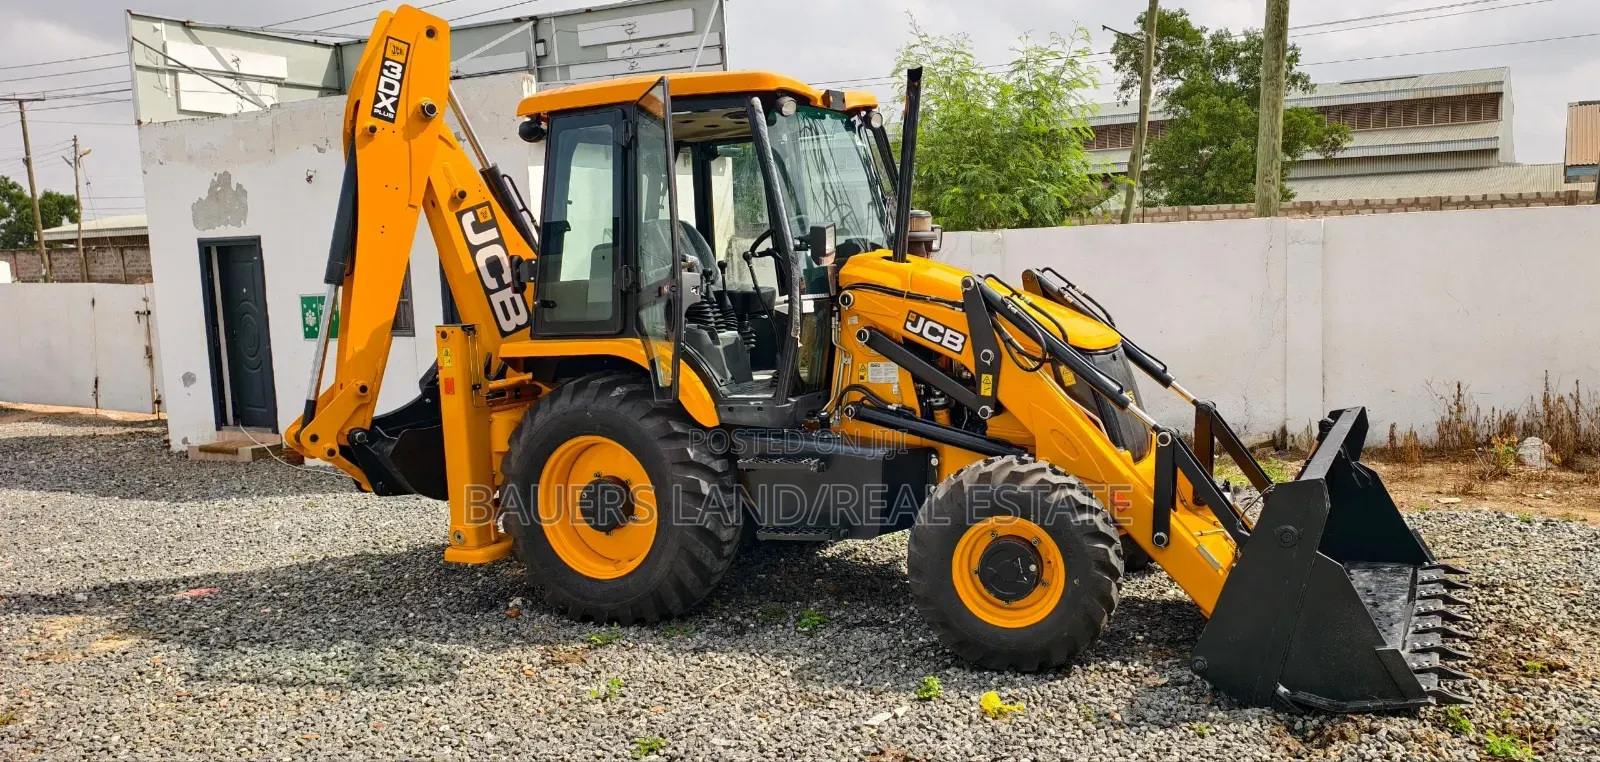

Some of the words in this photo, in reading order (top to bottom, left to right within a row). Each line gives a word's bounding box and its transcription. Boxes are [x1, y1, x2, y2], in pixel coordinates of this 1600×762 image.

[374, 60, 403, 114] 3DX
[373, 108, 395, 119] PLUS
[461, 211, 528, 332] JCB
[905, 316, 965, 352] JCB
